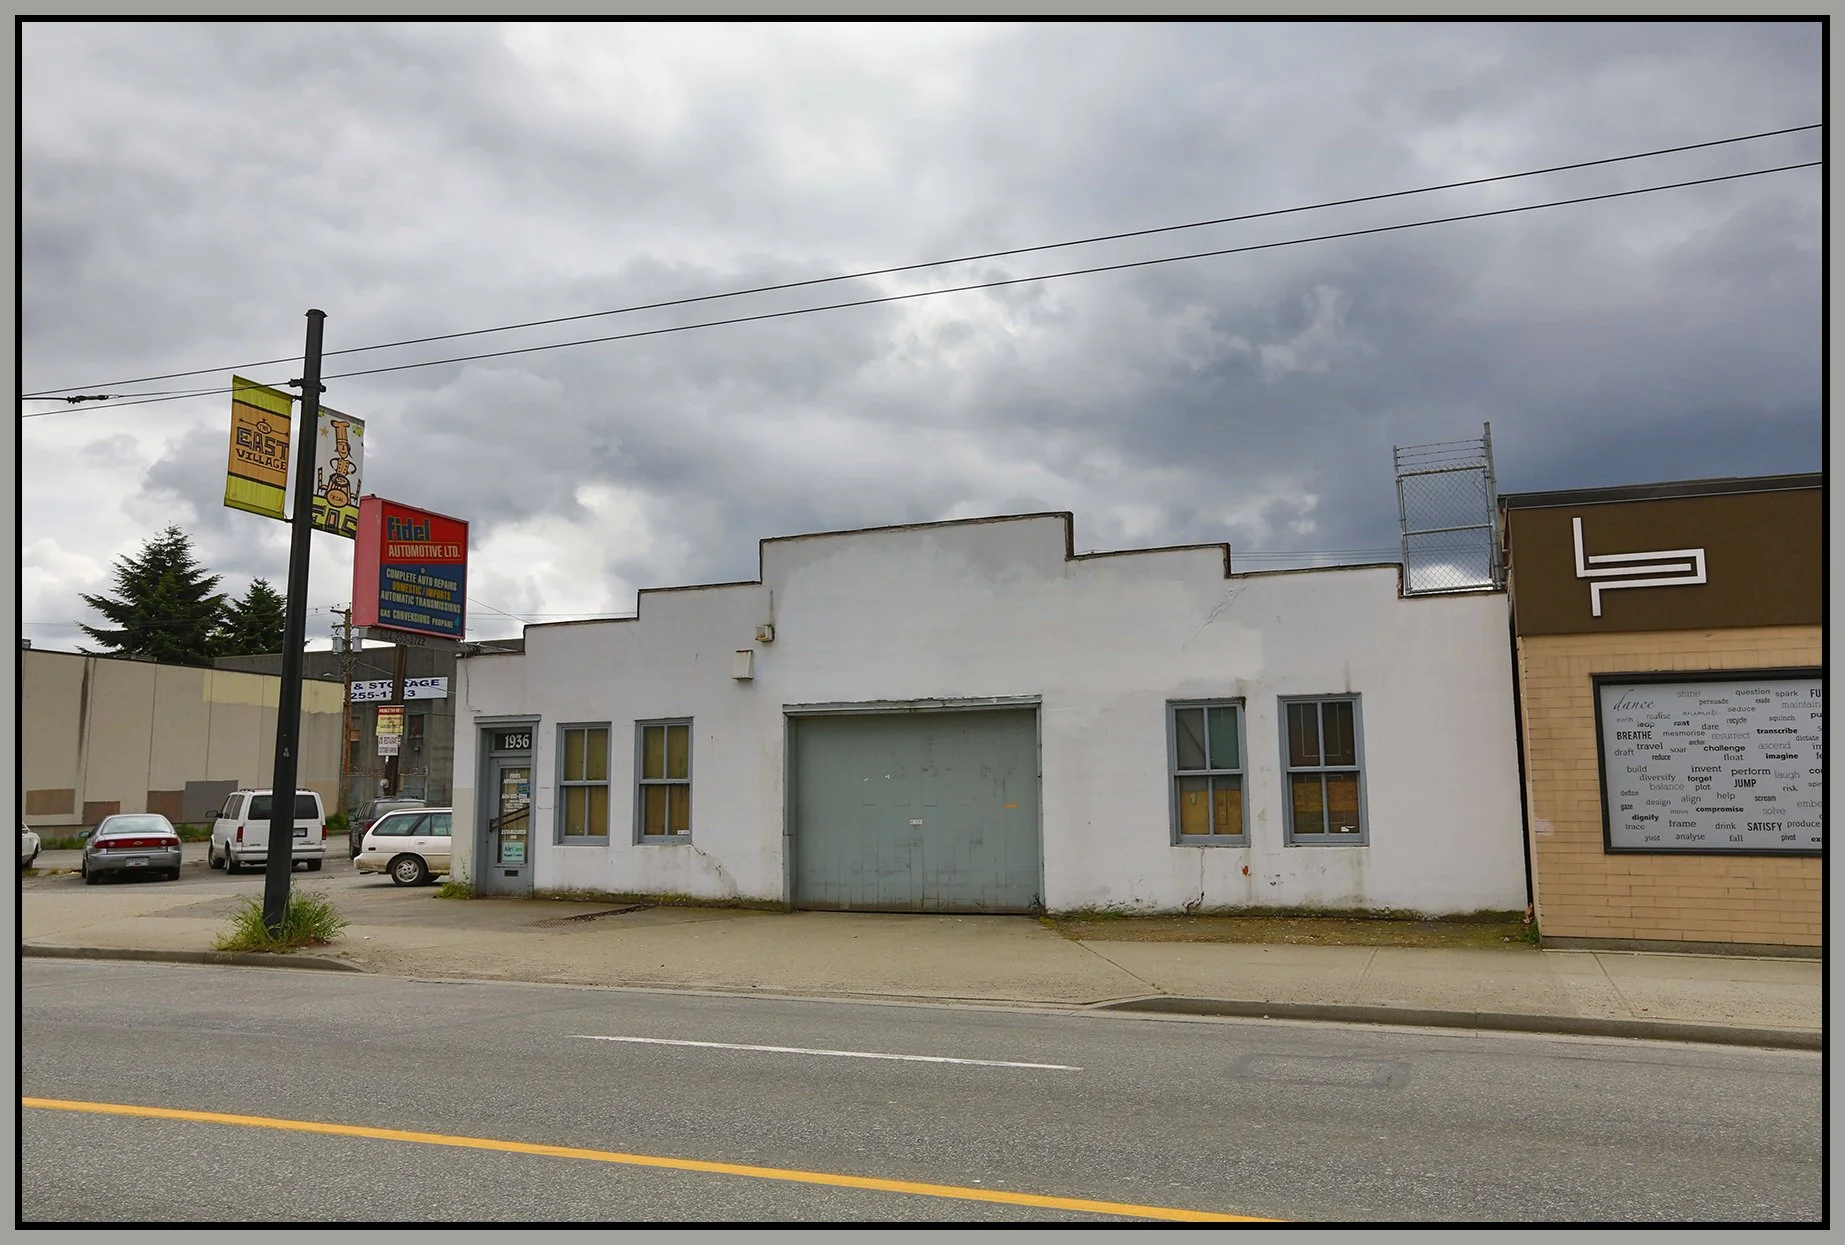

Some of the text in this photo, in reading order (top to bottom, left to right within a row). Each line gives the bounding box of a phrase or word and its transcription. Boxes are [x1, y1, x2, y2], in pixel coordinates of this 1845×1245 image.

[236, 427, 289, 460] EAST
[235, 448, 287, 470] VILLAGE
[386, 515, 431, 542] fidel
[388, 545, 461, 558] AUTOMOTIVE LTD.
[386, 568, 458, 592] COMPLETE AUTO REPAIRS
[392, 581, 422, 596] DOMESTIC
[426, 588, 452, 601] IMPORTS
[381, 590, 462, 614] AUTOMATIC TRANSMISSIONS
[380, 608, 455, 629] GAS CONVERSIONS PROPANE
[353, 682, 363, 691] &
[1677, 690, 1701, 698] shine
[1735, 688, 1771, 697] question
[1775, 690, 1799, 698] spark
[1809, 688, 1823, 698] FU
[1613, 688, 1656, 711] dance
[1781, 700, 1821, 709] maintain
[1727, 705, 1756, 713] seduce
[1646, 711, 1671, 720] realise
[1637, 721, 1656, 729] leap
[1701, 722, 1720, 731] dare
[1616, 730, 1652, 740] BREATHE
[1711, 730, 1751, 740] resurrect
[1756, 727, 1798, 735] transcribe
[504, 734, 530, 749] 1936
[1636, 741, 1664, 751] travel
[1758, 741, 1792, 750] ascend
[1614, 747, 1635, 757] draft
[1703, 744, 1746, 753] challenge
[1651, 753, 1672, 761] reduce
[1723, 752, 1744, 761] float
[1765, 752, 1799, 761] imagine
[1626, 765, 1648, 774] build
[1691, 765, 1722, 773] invent
[1731, 767, 1771, 777] perform
[1639, 774, 1677, 783] diversify
[1687, 775, 1713, 784] forget
[1774, 770, 1800, 780] laugh
[1649, 782, 1685, 791] balance
[1695, 783, 1711, 792] plot
[1733, 778, 1757, 788] JUMP
[1782, 784, 1799, 792] risk
[1681, 794, 1702, 805] align
[1716, 791, 1736, 801] help
[1754, 794, 1777, 802] scream
[1645, 799, 1672, 808] design
[1695, 805, 1745, 814] compromise
[1762, 807, 1787, 816] solve
[1631, 813, 1660, 823] dignify
[1625, 823, 1646, 831] trace
[1668, 819, 1697, 829] frame
[1714, 821, 1737, 831] drink
[1746, 821, 1783, 832] SATISFY
[1787, 819, 1821, 829] produce
[1675, 832, 1706, 842] analyse
[1729, 833, 1744, 843] fall
[1781, 833, 1797, 843] pivot
